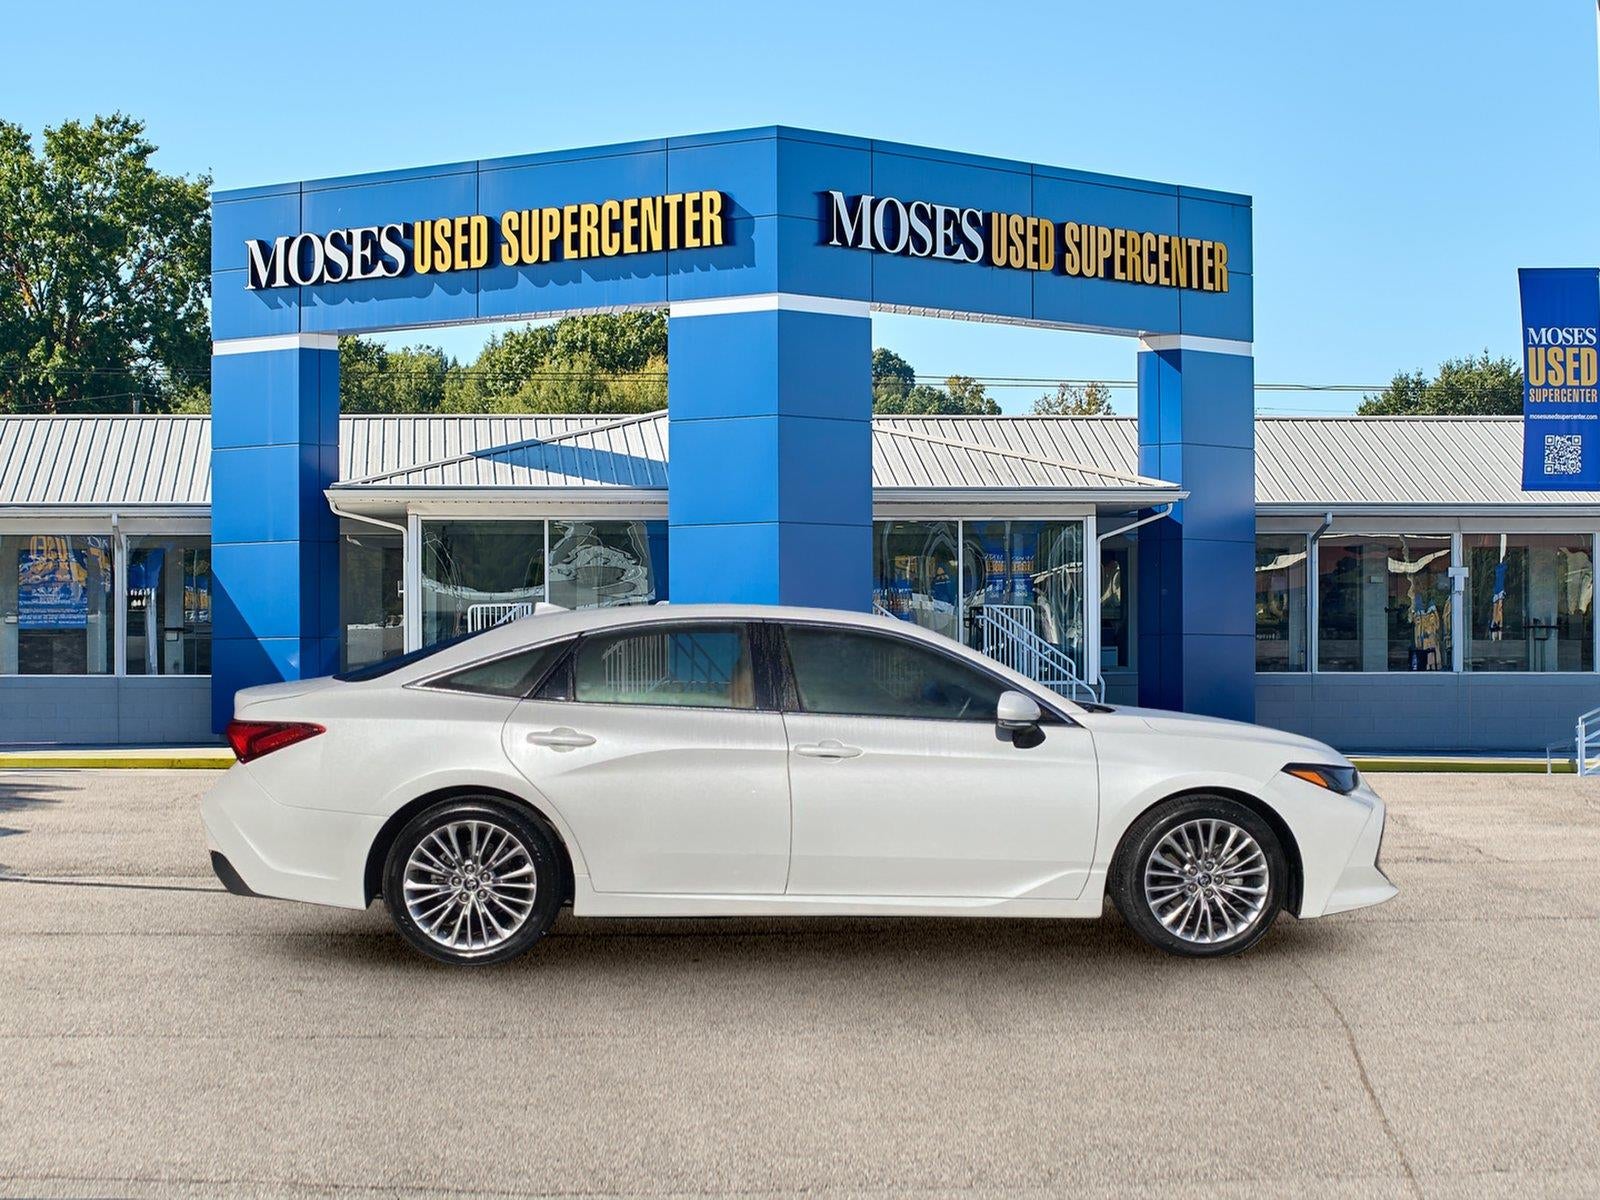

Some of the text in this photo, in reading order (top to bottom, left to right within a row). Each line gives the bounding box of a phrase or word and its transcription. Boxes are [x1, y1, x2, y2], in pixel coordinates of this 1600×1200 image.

[245, 190, 724, 290] MOSES USED SUPERCENTER
[828, 190, 1229, 293] MOSES USED SUPERCENTER
[1527, 327, 1597, 345] MOSES
[1528, 347, 1598, 387] USED
[1529, 388, 1598, 403] SUPERCENTER
